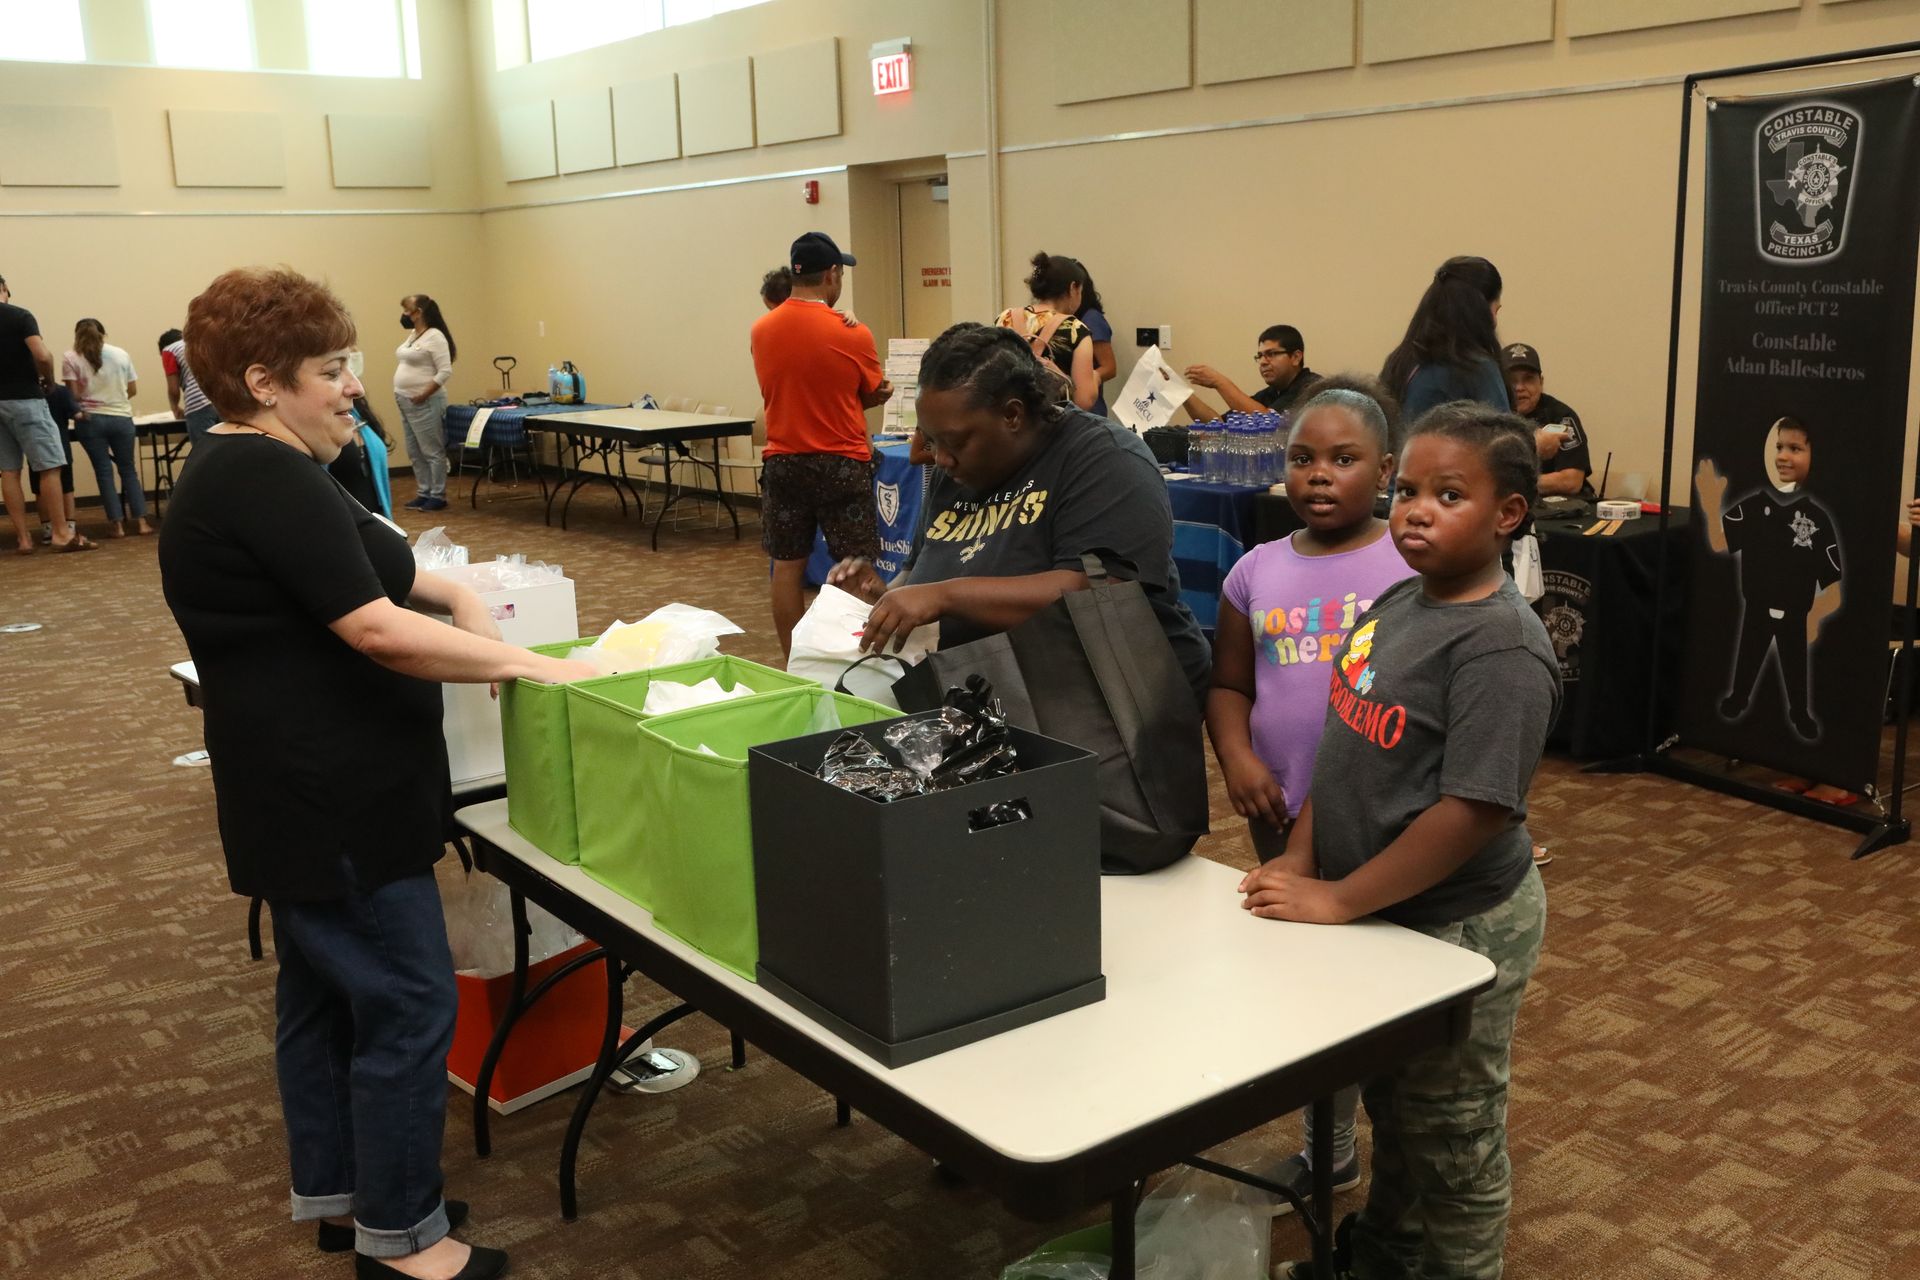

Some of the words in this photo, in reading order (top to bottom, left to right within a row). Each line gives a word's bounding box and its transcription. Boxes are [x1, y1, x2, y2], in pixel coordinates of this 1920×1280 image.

[877, 57, 904, 90] EXIT
[1763, 109, 1854, 137] CONSTABLE
[1776, 127, 1805, 141] TRAVIS
[1806, 126, 1841, 138] COUNTY
[1767, 242, 1823, 257] PRECINCT
[1826, 240, 1834, 251] 2
[1784, 234, 1819, 245] TEXAS
[1719, 279, 1758, 294] Travis
[1760, 279, 1808, 299] County
[1811, 279, 1884, 295] Constable
[1755, 300, 1796, 315] Office
[1797, 301, 1828, 316] PCT
[1830, 302, 1839, 316] 2
[1752, 331, 1837, 352] Constable
[1726, 356, 1766, 376] Adan
[1768, 358, 1866, 381] Ballesteros
[926, 490, 1048, 542] SAINTS
[953, 501, 979, 512] NEW
[880, 537, 912, 555] lueShi
[875, 558, 897, 573] exas
[1543, 574, 1592, 597] NSTABLE
[1252, 592, 1375, 643] positi
[1263, 631, 1348, 666] ener
